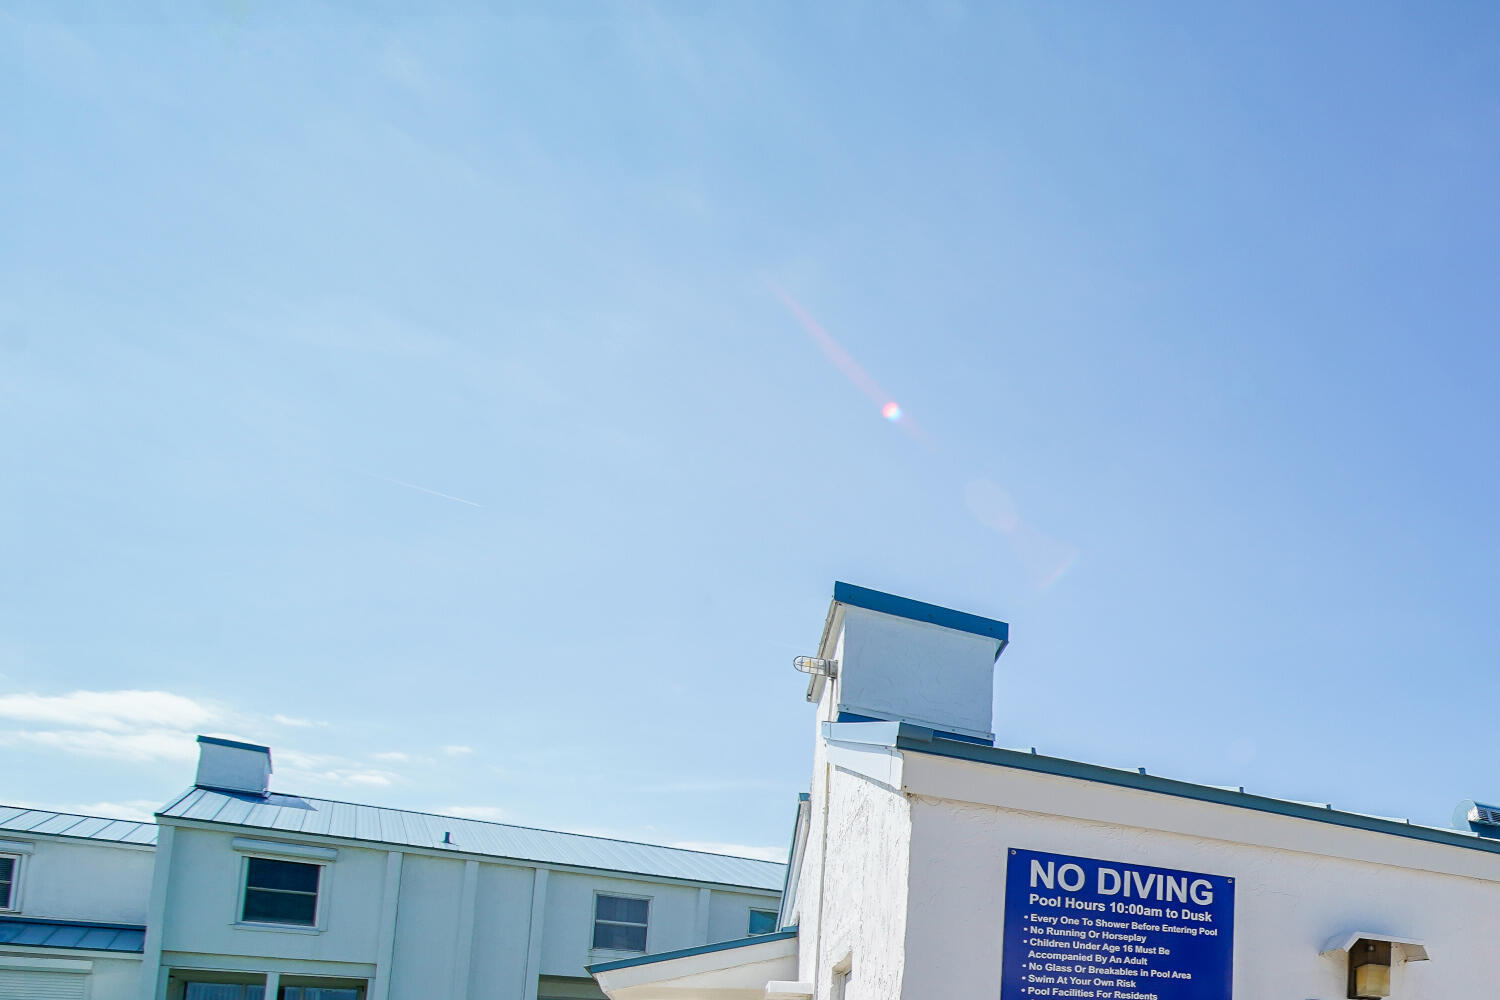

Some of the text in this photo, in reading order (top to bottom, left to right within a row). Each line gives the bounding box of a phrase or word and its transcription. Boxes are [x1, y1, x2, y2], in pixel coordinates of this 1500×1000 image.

[1030, 860, 1213, 905] NO DIVING
[1029, 894, 1212, 922] Pool Hours 10:00am to Dusk
[1031, 914, 1218, 936] Every One To Shower Before Entering Pool
[1030, 926, 1147, 943] No Running Or Horseplay
[1030, 938, 1170, 955] Children Under Age 16 Must Be
[1028, 951, 1147, 965] Accompanied By An Adult
[1029, 963, 1042, 971] No
[1045, 964, 1072, 973] Glass
[1074, 965, 1086, 973] Or
[1088, 966, 1138, 977] Breakables
[1150, 969, 1170, 978] Pool
[1172, 971, 1191, 979] Area
[1028, 975, 1136, 988] Swim At Your Own Risk
[1028, 987, 1158, 1000] Pool Facilities For Residents
